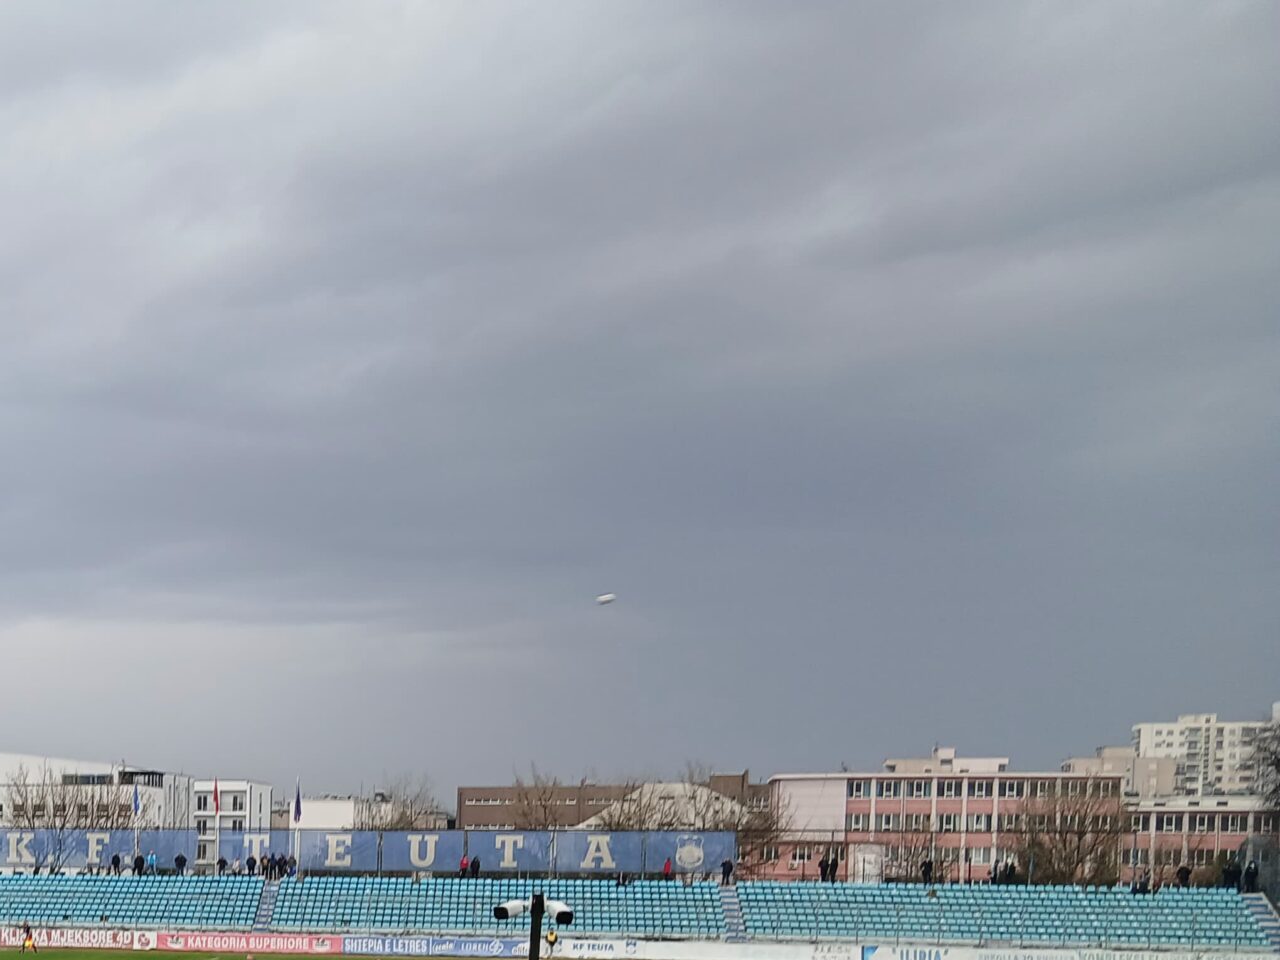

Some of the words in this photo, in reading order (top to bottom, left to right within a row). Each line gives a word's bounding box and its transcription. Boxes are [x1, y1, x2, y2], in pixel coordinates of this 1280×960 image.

[243, 833, 616, 868] TEUTA
[1, 928, 48, 945] KLIKA
[187, 935, 246, 949] KATEGORIA
[249, 936, 309, 950] SUPERIORE
[385, 939, 391, 952] E
[573, 943, 585, 951] KF
[587, 943, 614, 951] TEUTA
